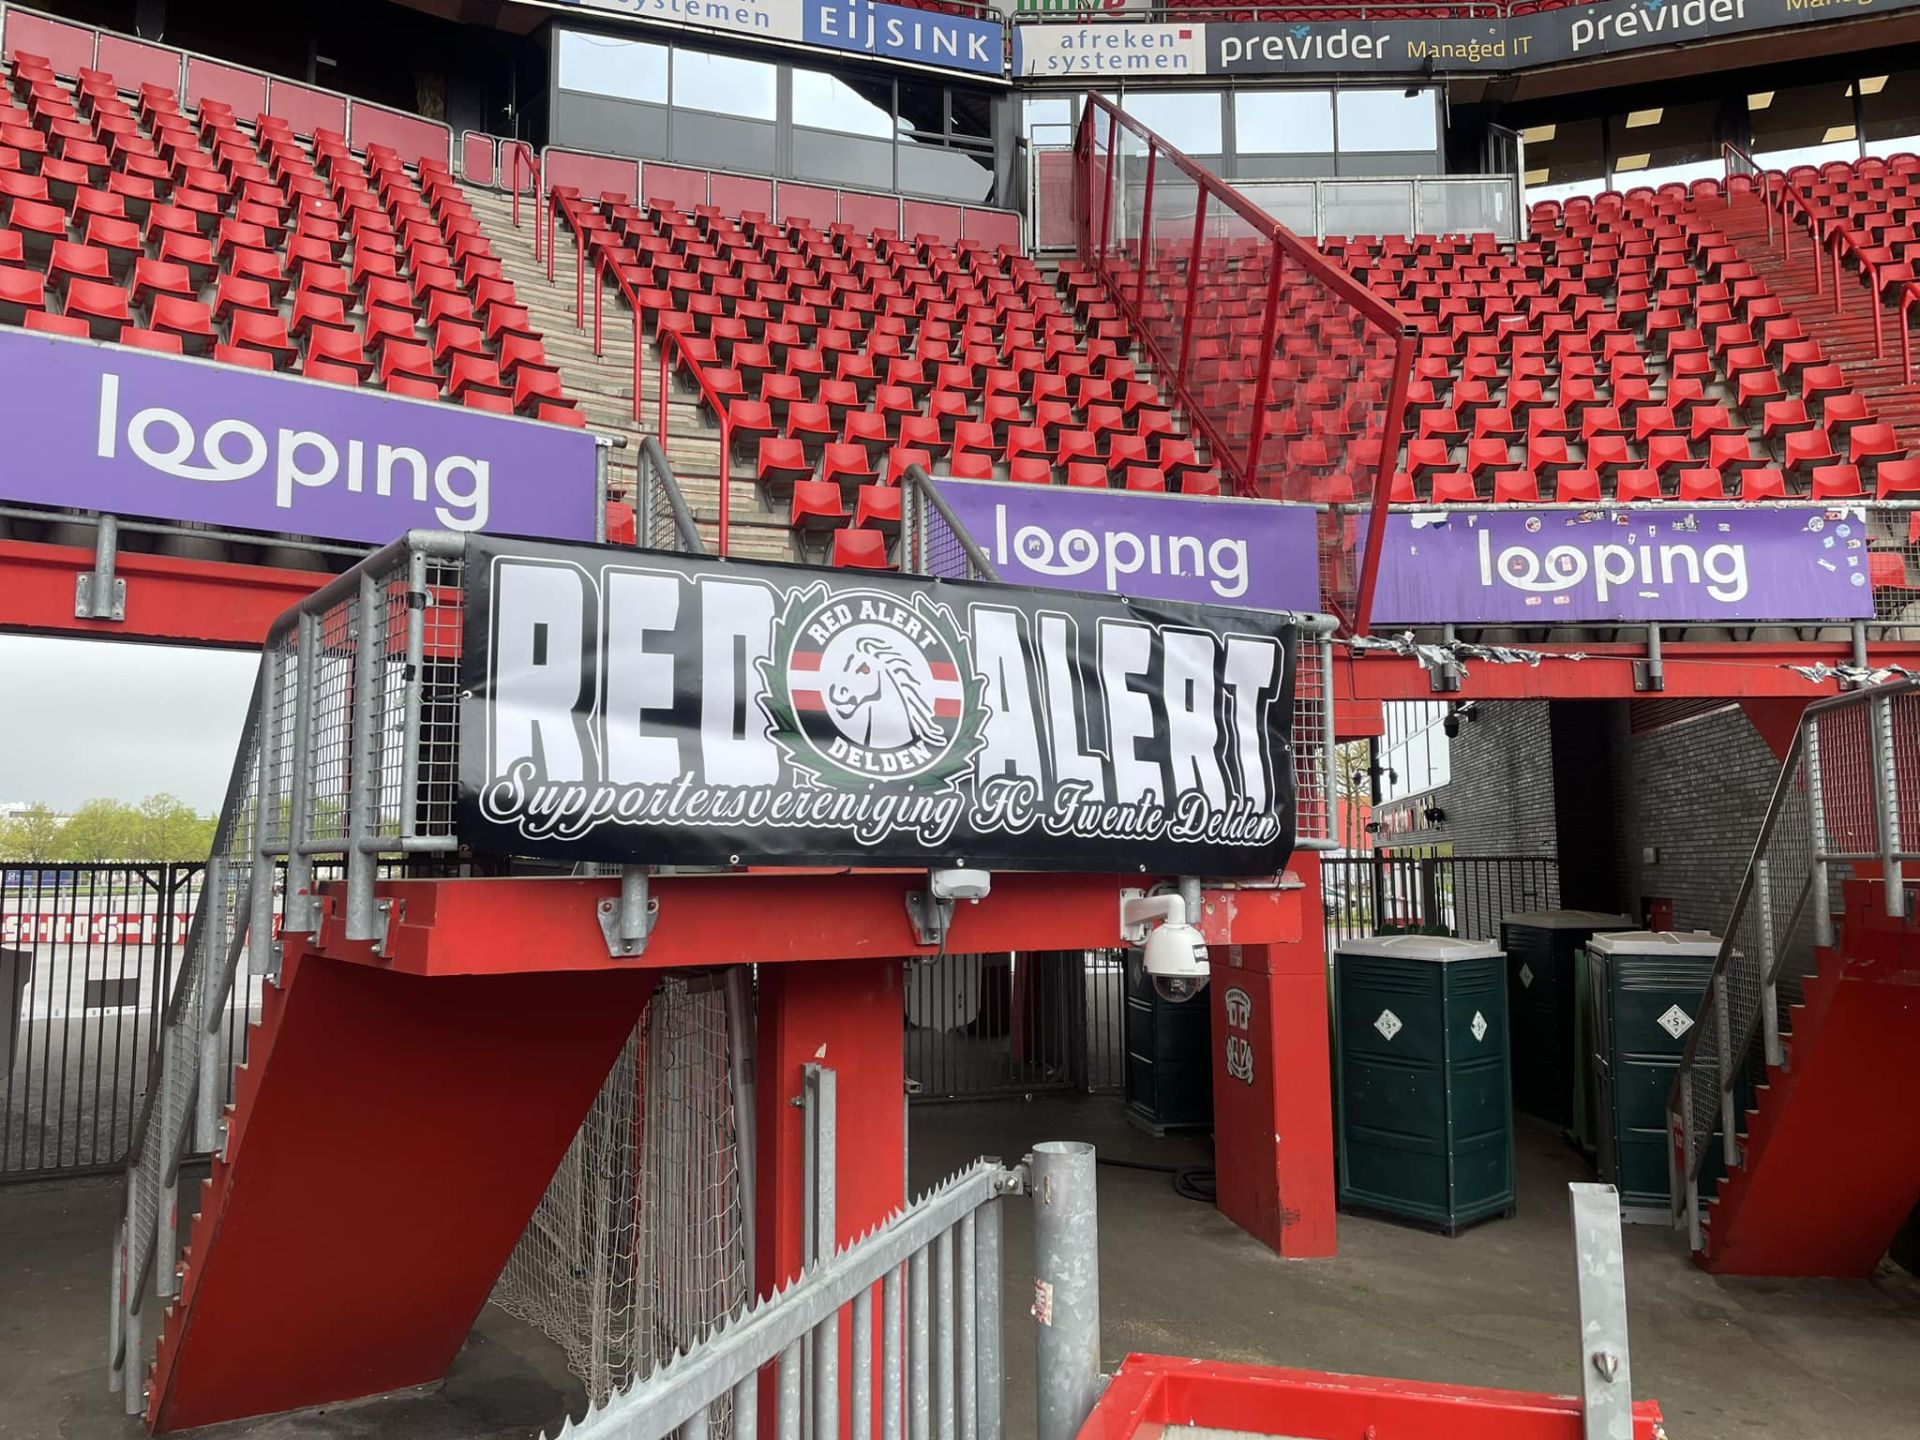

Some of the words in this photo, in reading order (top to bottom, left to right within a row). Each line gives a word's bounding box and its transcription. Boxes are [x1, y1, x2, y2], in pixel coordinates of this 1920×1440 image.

[1048, 51, 1188, 74] systemen
[1060, 29, 1174, 48] afreken
[1221, 28, 1391, 67] previder
[1407, 40, 1506, 62] Managed
[1513, 36, 1533, 55] IT
[97, 373, 490, 532] looping
[995, 504, 1249, 598] looping
[1478, 528, 1749, 602] looping
[807, 603, 853, 646] RED
[859, 600, 938, 650] ALERT
[496, 563, 779, 787] RED
[974, 608, 1276, 813] ALERT
[827, 736, 932, 773] DELDEN
[488, 761, 960, 839] Supportersvereniging
[975, 778, 1034, 827] FC
[1172, 791, 1278, 840] Delden
